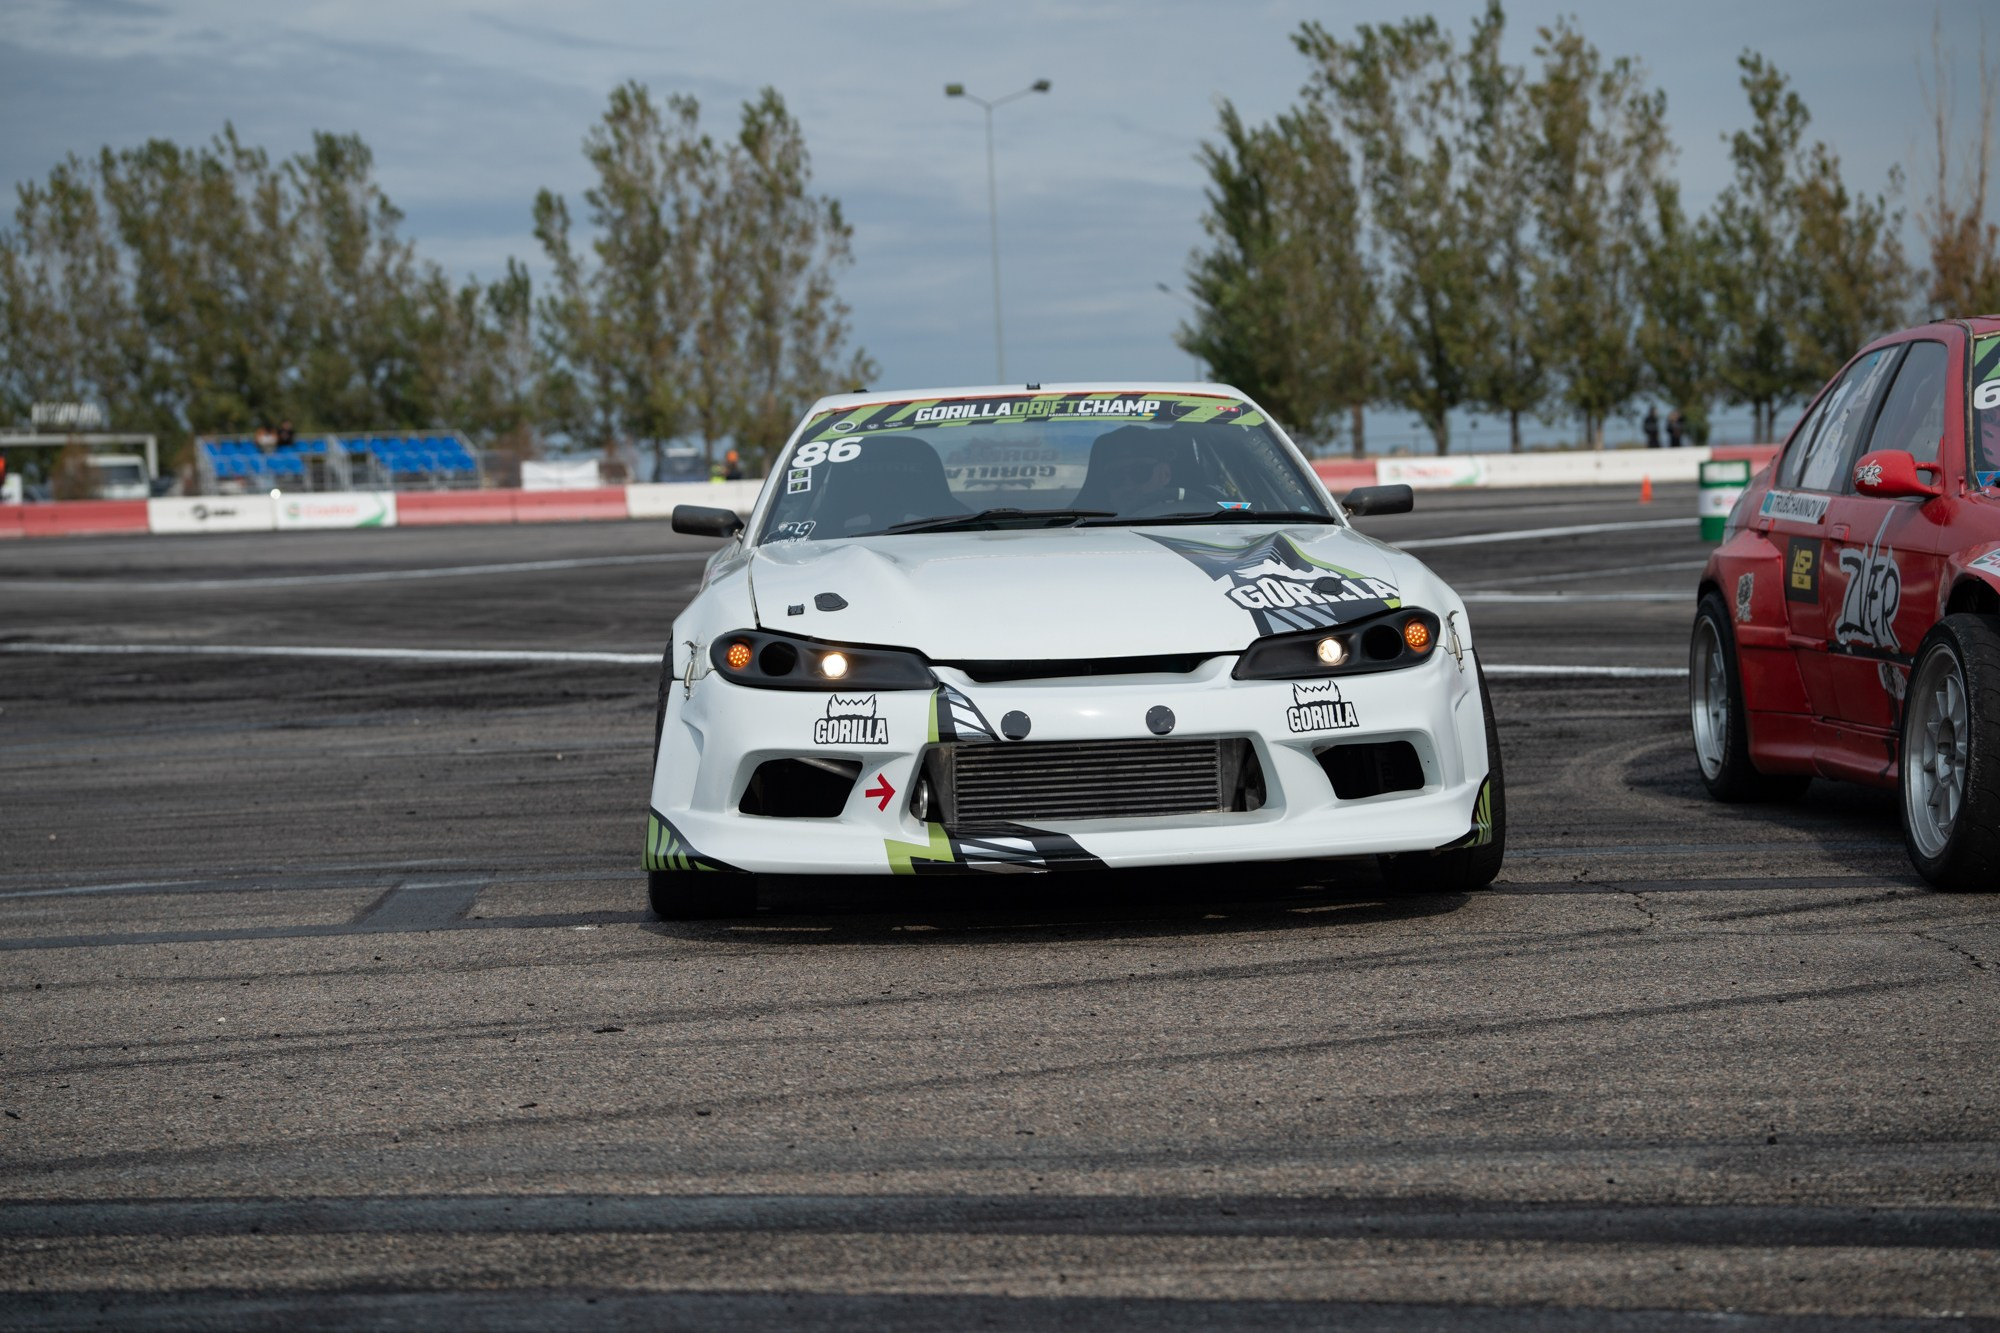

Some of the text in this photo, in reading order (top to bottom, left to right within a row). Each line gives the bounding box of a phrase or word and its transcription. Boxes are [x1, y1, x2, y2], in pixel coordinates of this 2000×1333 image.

[792, 436, 864, 468] 86
[1836, 507, 1902, 650] ZVER
[814, 718, 889, 744] GORILLA
[1287, 701, 1359, 733] GORILLA
